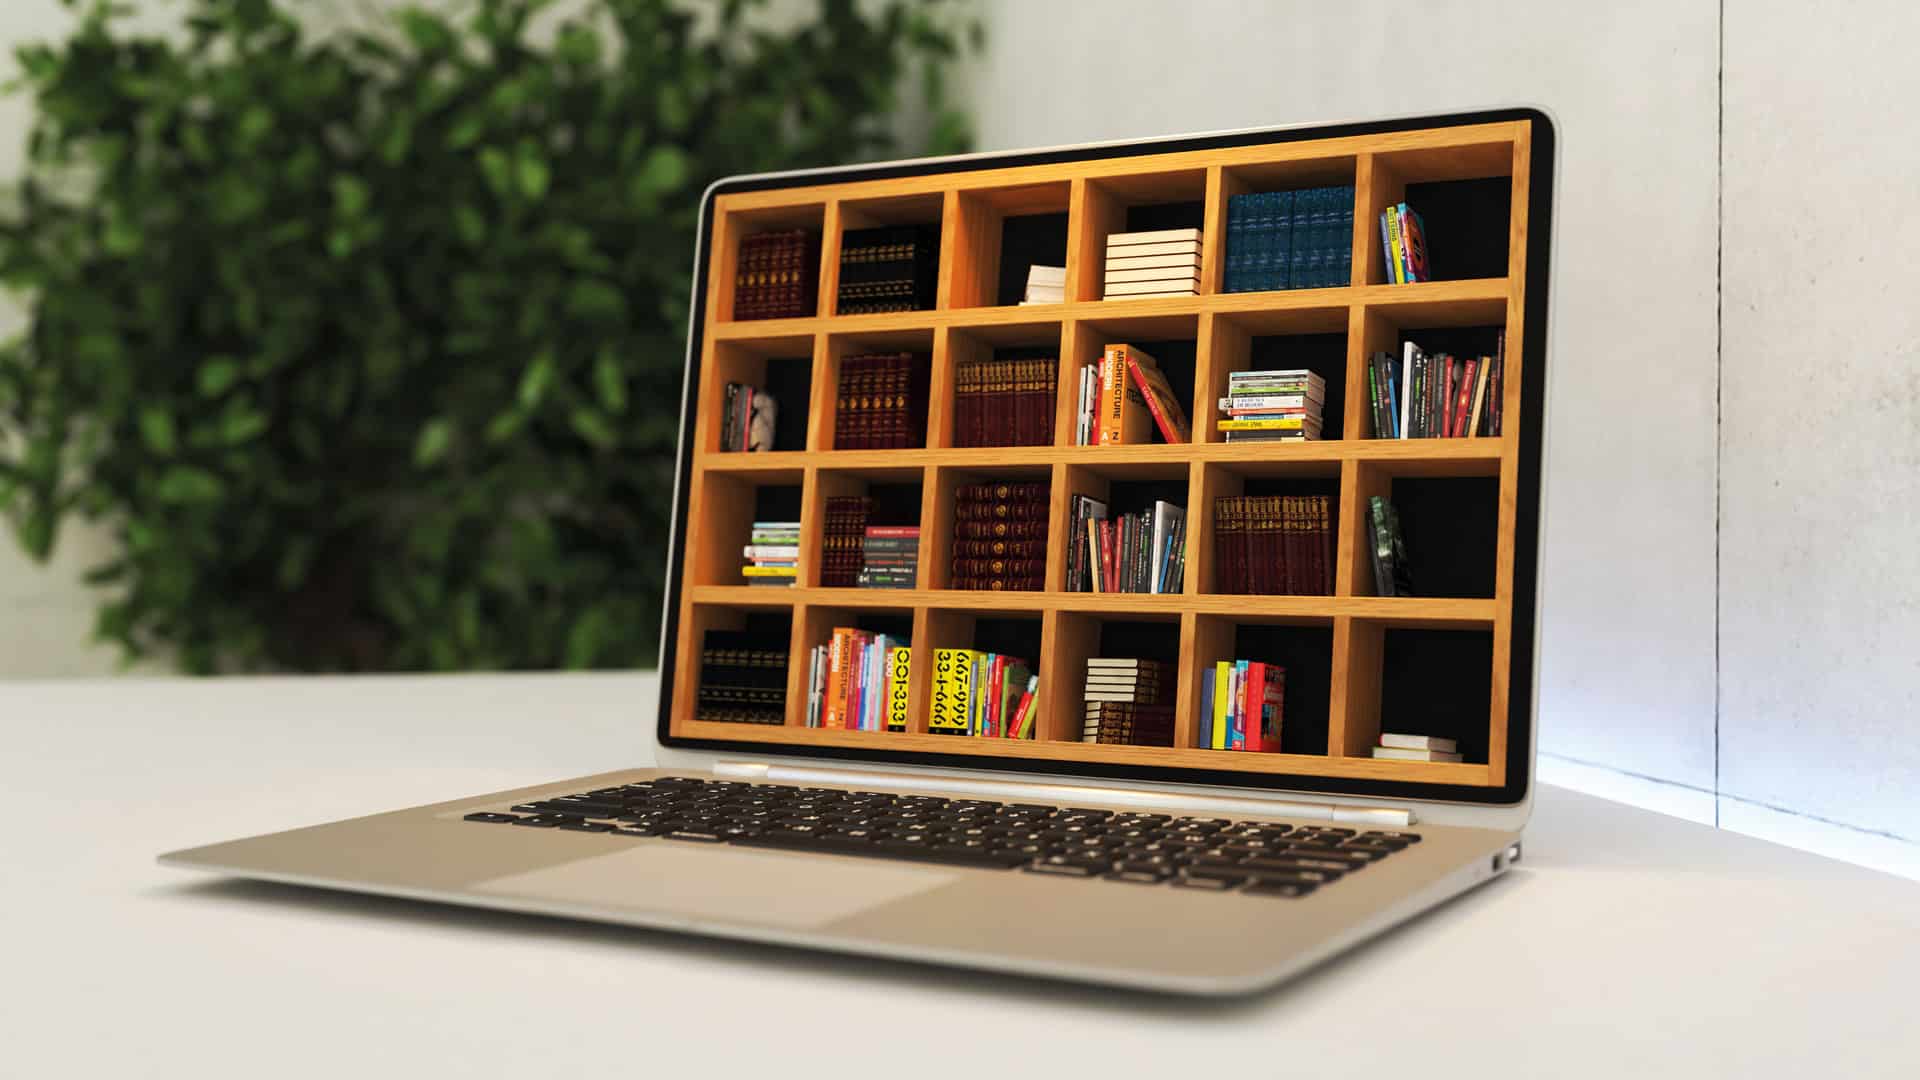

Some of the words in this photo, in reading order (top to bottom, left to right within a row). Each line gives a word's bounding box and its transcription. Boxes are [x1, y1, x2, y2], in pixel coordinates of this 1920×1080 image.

[1112, 350, 1124, 419] ARCHITECTURE
[892, 649, 910, 722] 001-333
[951, 651, 970, 726] 667-999
